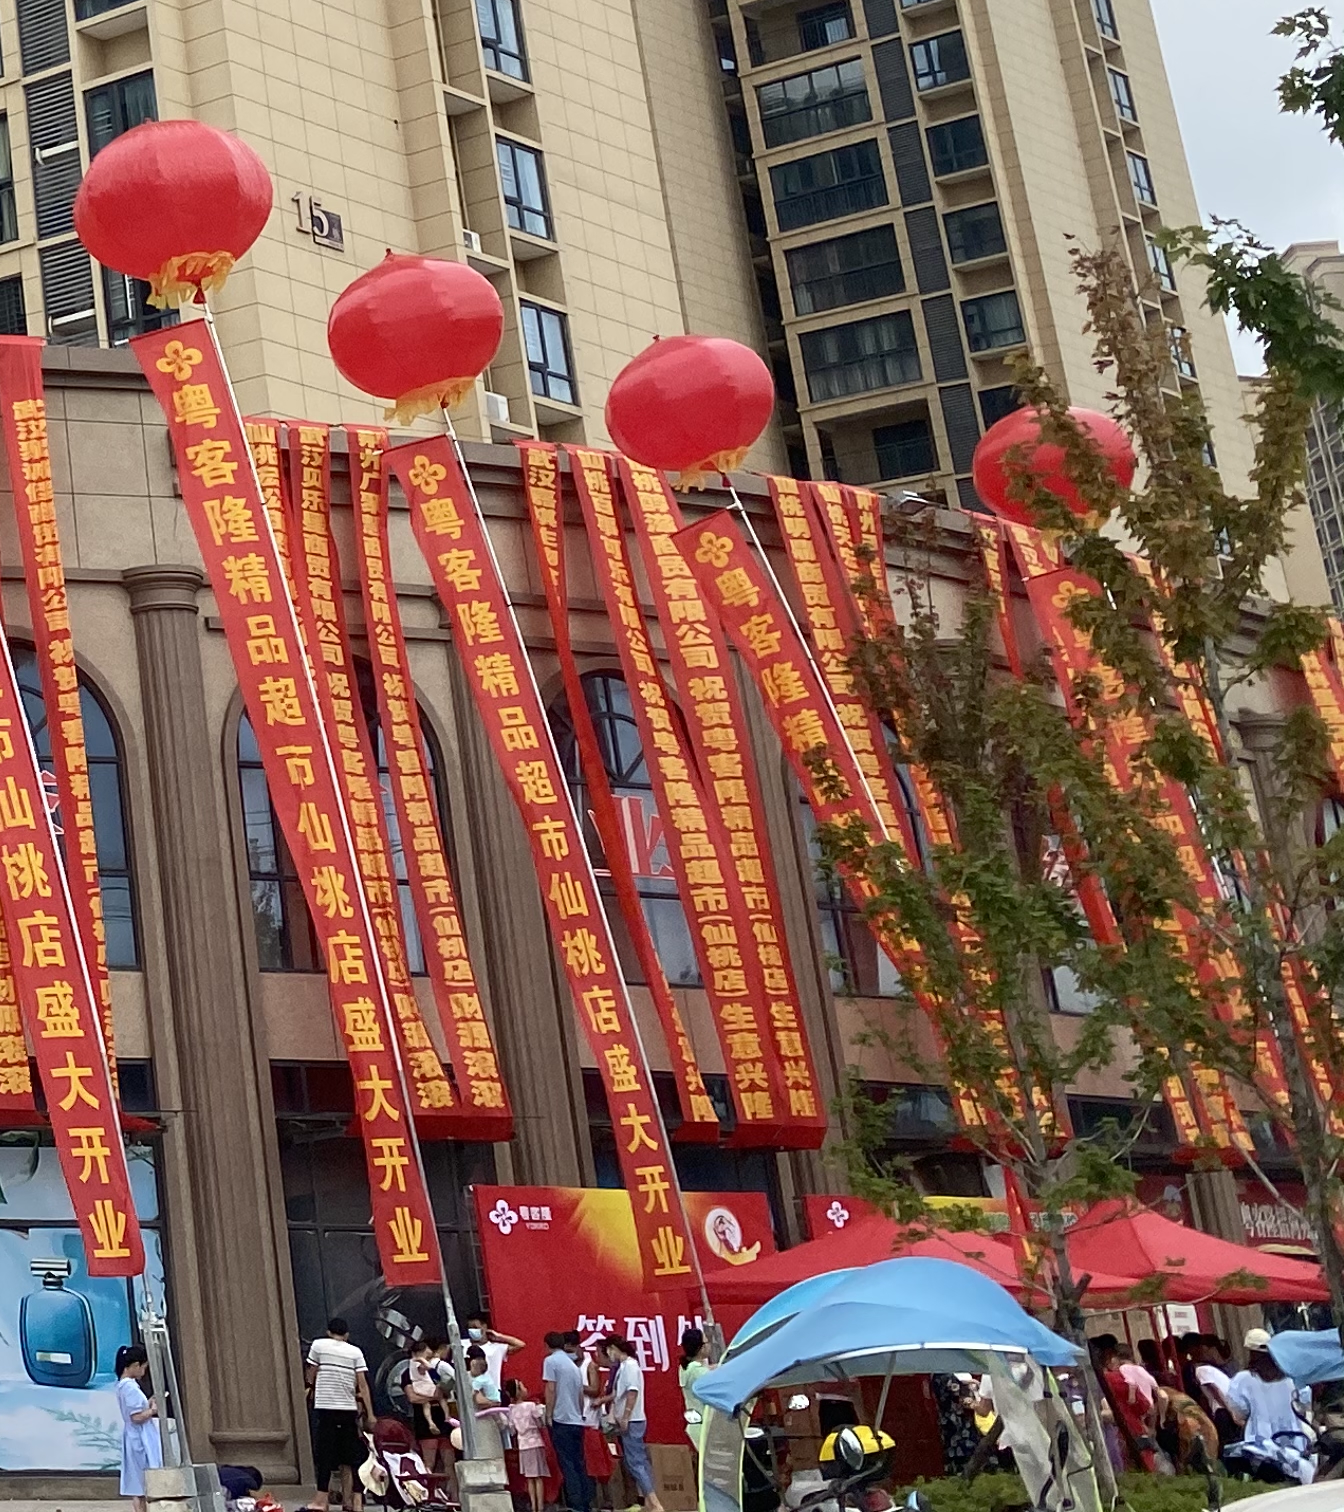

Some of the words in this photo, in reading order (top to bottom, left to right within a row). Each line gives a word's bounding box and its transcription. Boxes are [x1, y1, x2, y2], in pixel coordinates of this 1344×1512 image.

[292, 191, 329, 237] 15
[172, 383, 430, 1264] 粤客隆精品超市仙桃店盛大开业
[419, 497, 692, 1276] 粤客隆精品超市仙桃店盛大开业
